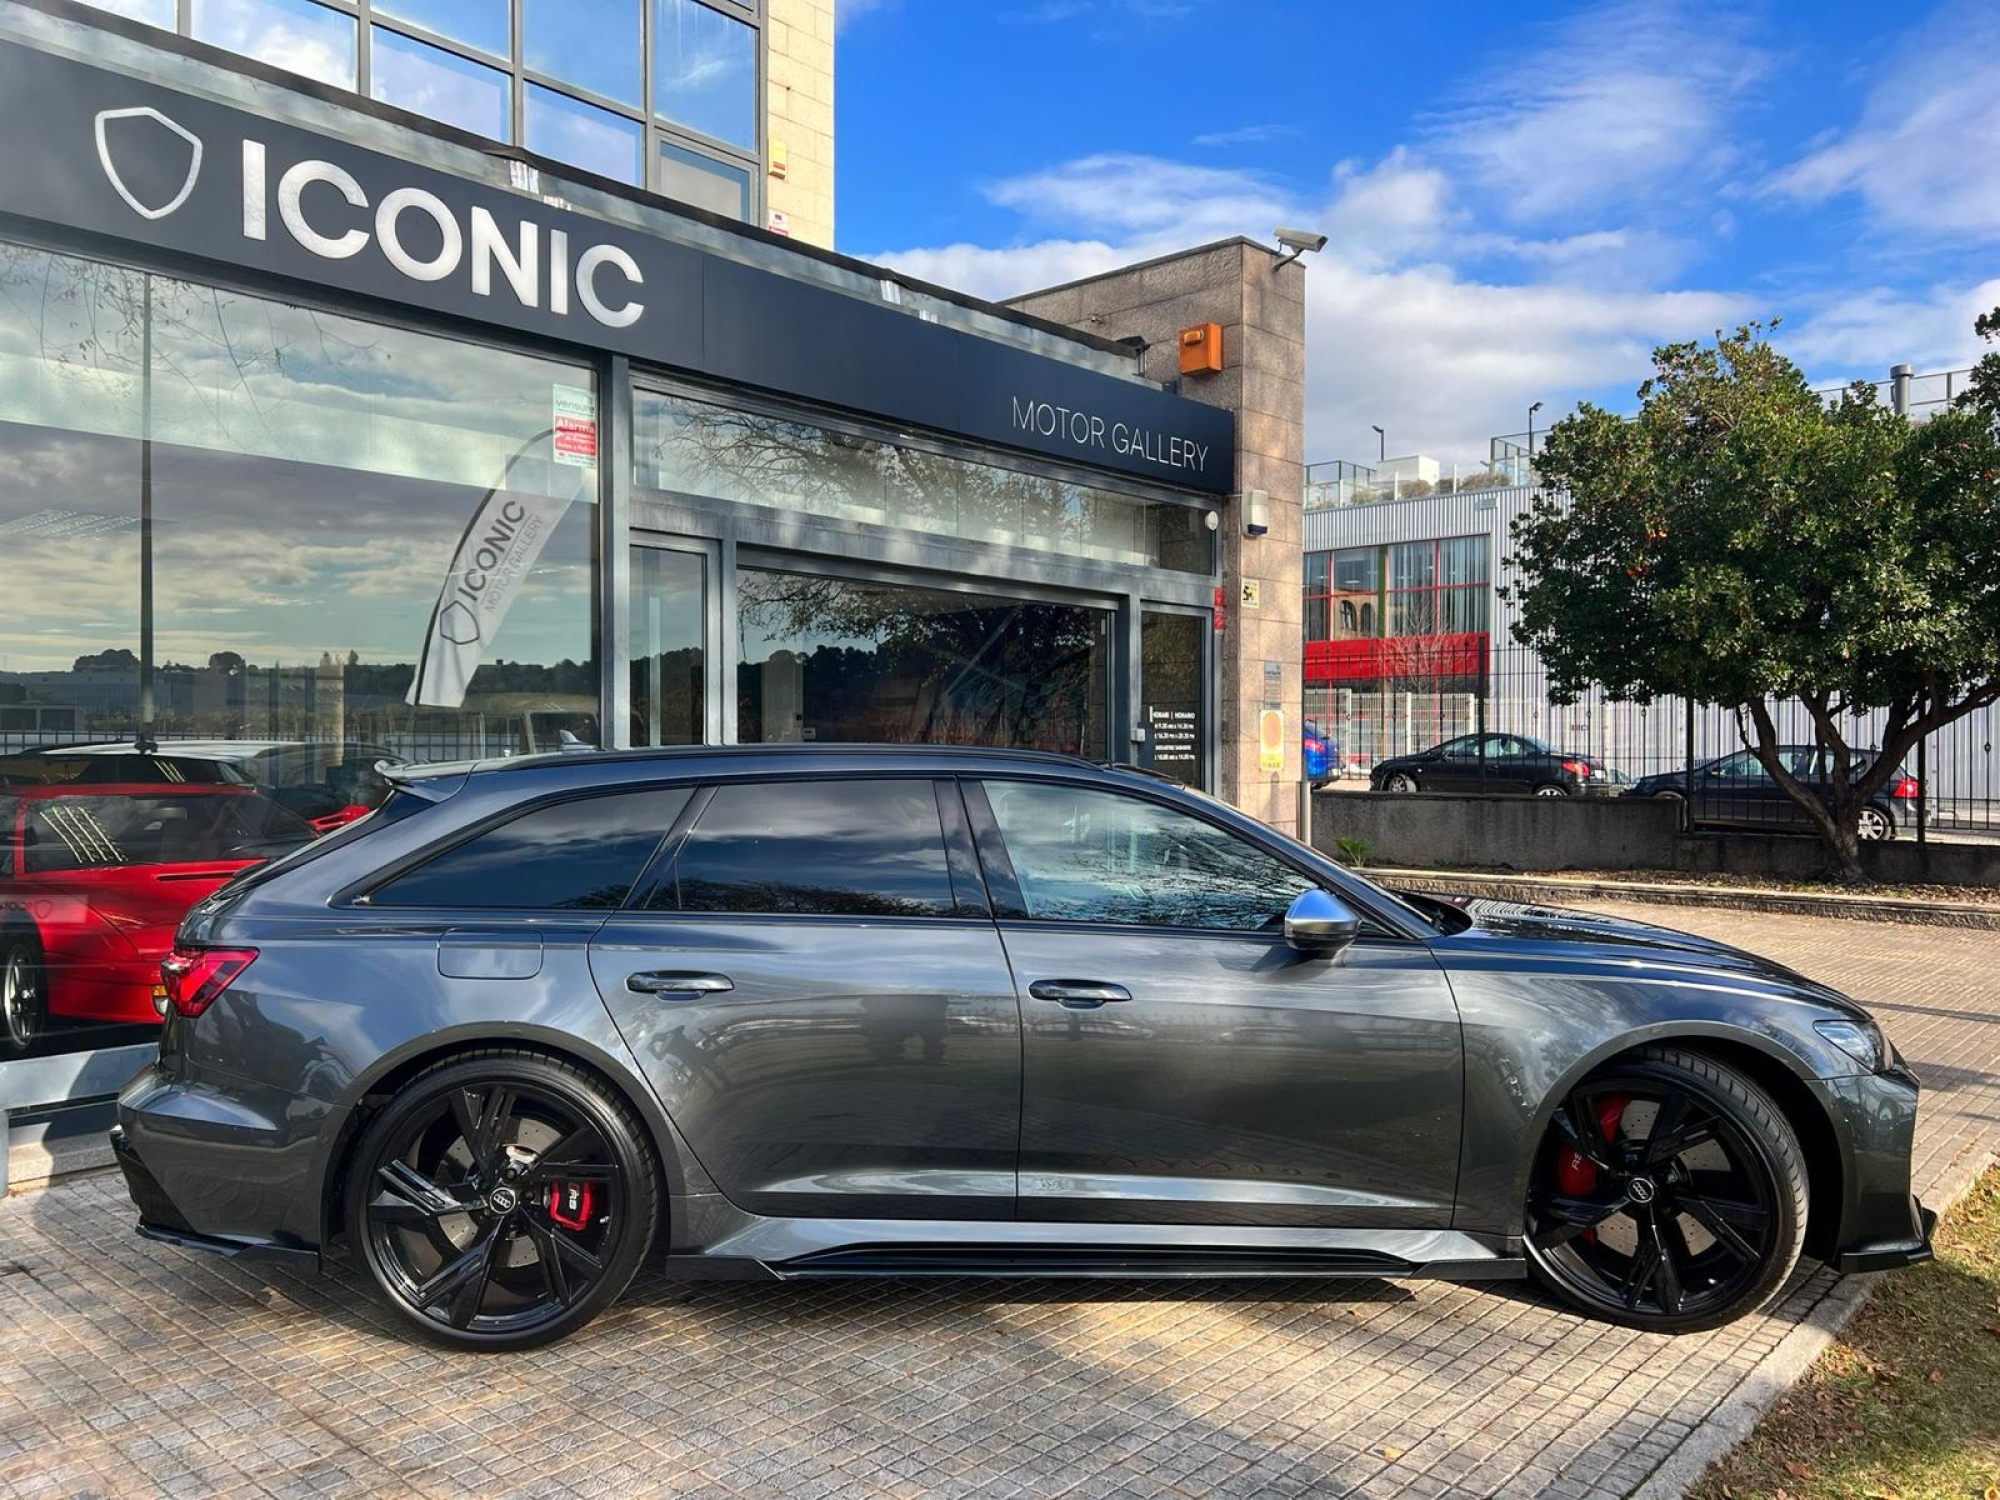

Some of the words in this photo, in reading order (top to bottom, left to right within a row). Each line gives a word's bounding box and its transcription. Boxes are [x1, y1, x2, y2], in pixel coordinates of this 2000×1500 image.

[242, 139, 645, 328] ICONIC
[1012, 395, 1105, 449] MOTOR
[1111, 423, 1209, 472] GALLERY
[457, 500, 525, 601] ICONIC
[509, 515, 544, 567] GALLERY
